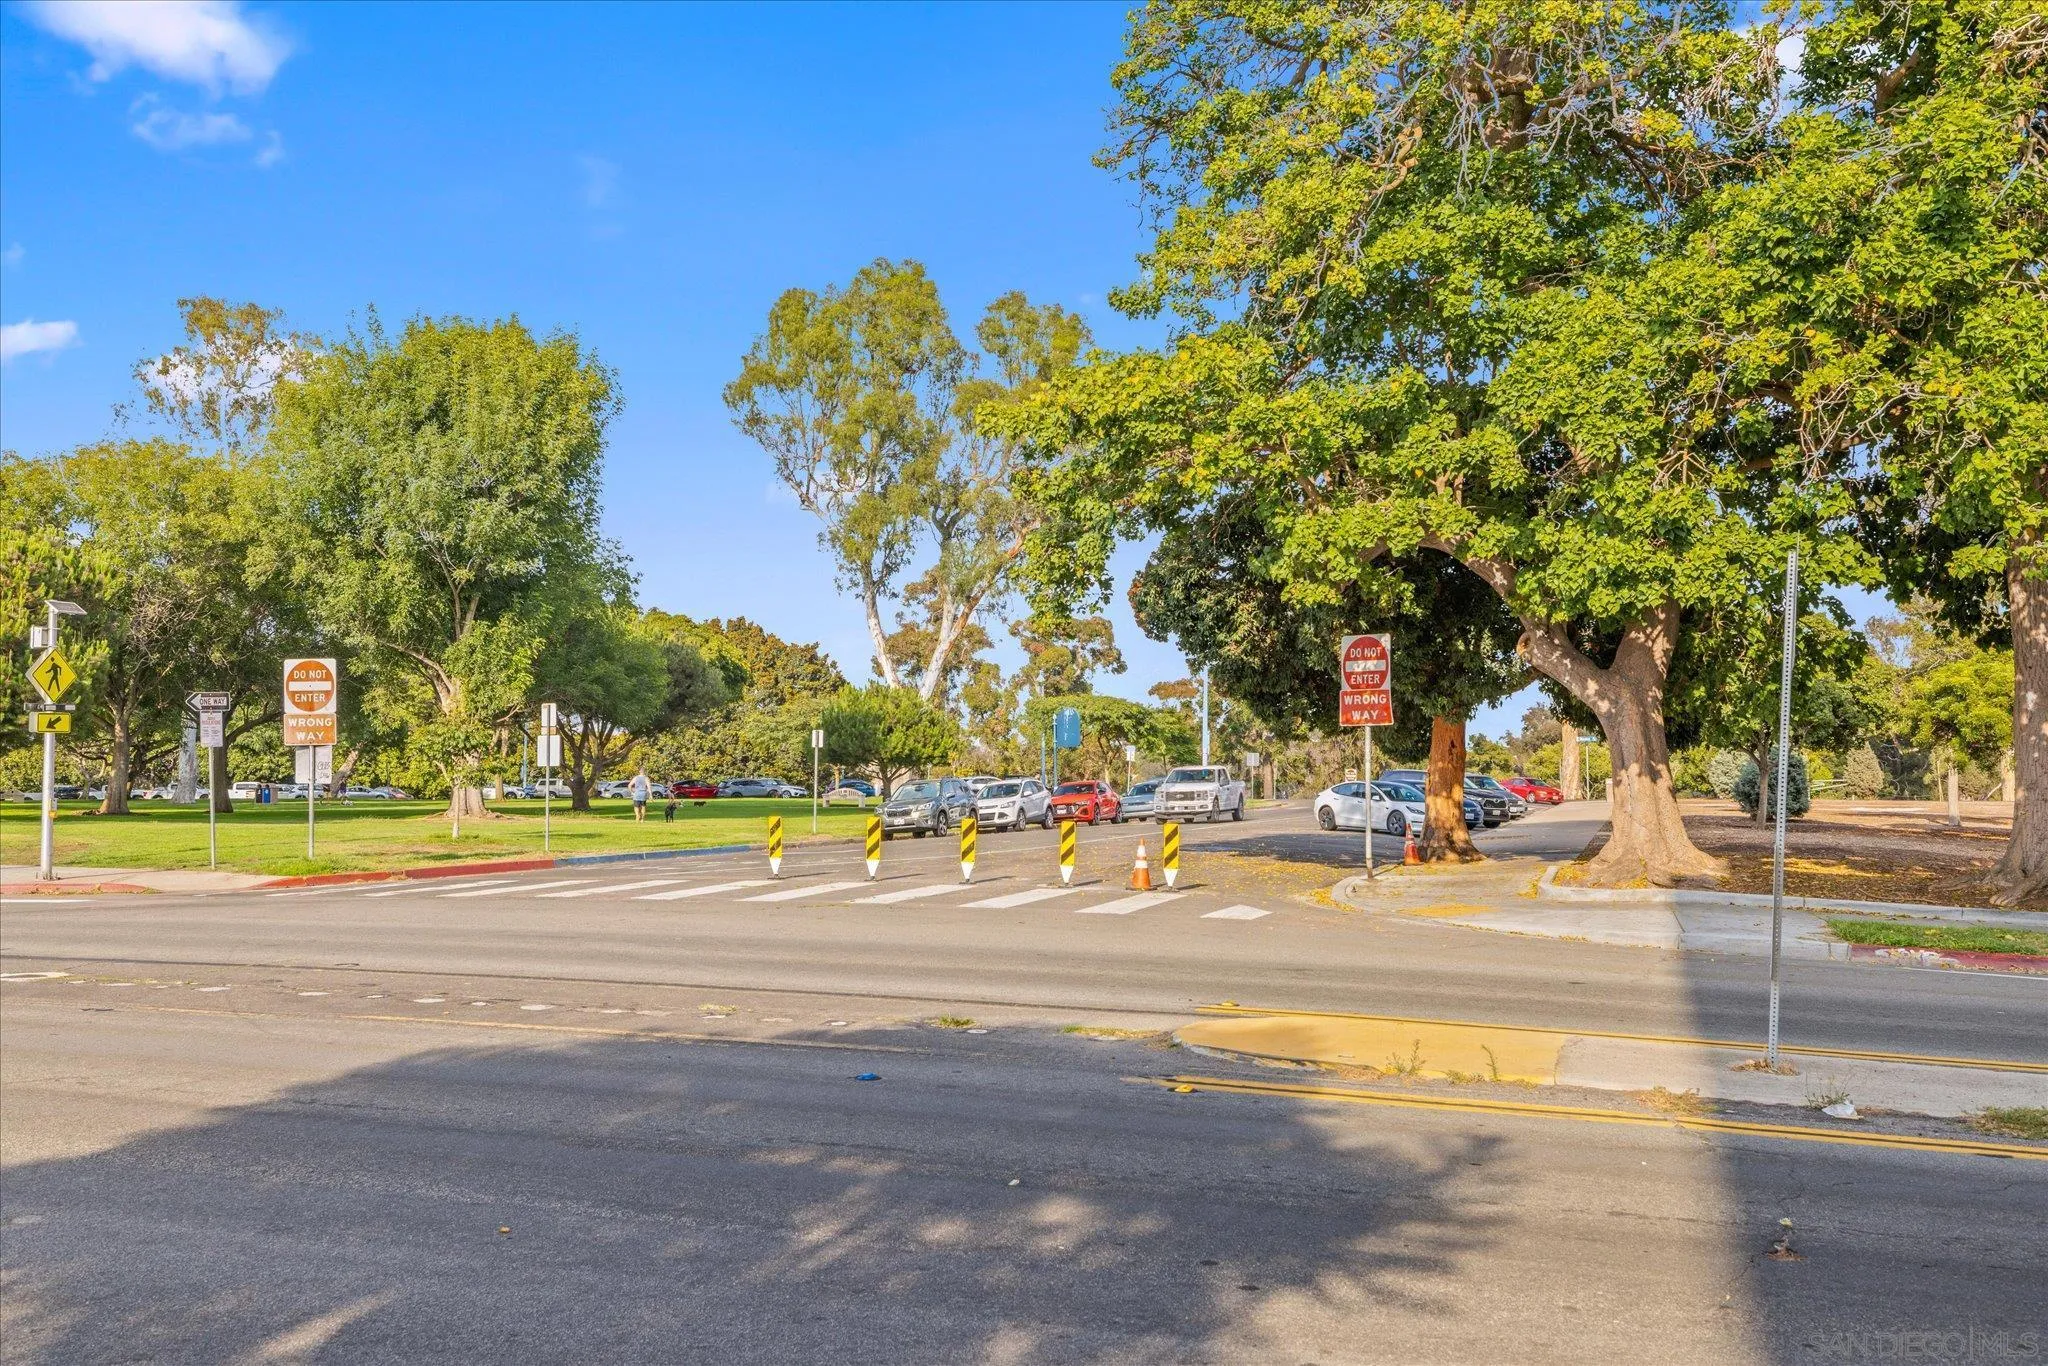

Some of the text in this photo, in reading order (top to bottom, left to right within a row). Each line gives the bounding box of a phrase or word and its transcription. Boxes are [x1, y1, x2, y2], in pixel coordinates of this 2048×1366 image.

[1350, 647, 1382, 658] DO NOT
[293, 670, 327, 679] DO NOT
[1350, 674, 1380, 684] ENTER
[200, 698, 211, 706] ONE
[294, 693, 326, 702] ENTER
[1344, 694, 1387, 705] WRONG
[1351, 710, 1379, 720] WAY
[288, 718, 332, 727] WRONG
[296, 731, 324, 740] WAY
